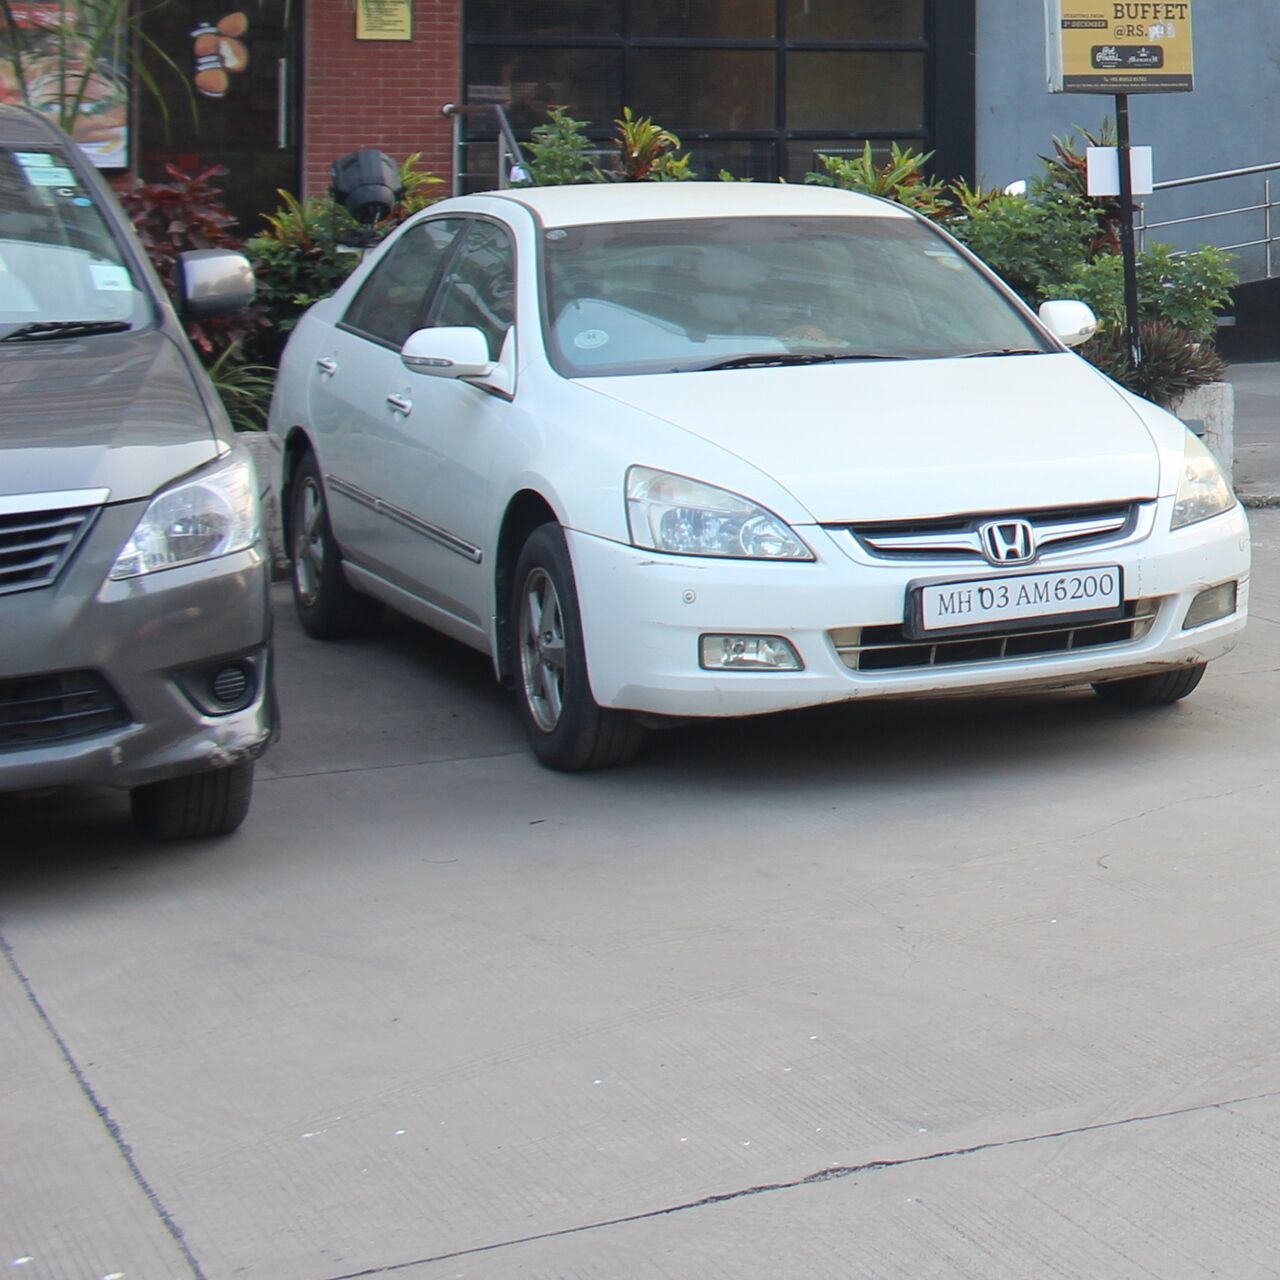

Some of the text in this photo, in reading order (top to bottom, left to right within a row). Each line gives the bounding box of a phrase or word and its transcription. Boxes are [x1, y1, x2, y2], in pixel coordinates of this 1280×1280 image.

[1113, 3, 1188, 20] BUFFET
[938, 590, 972, 616] MH
[979, 585, 1009, 610] 03
